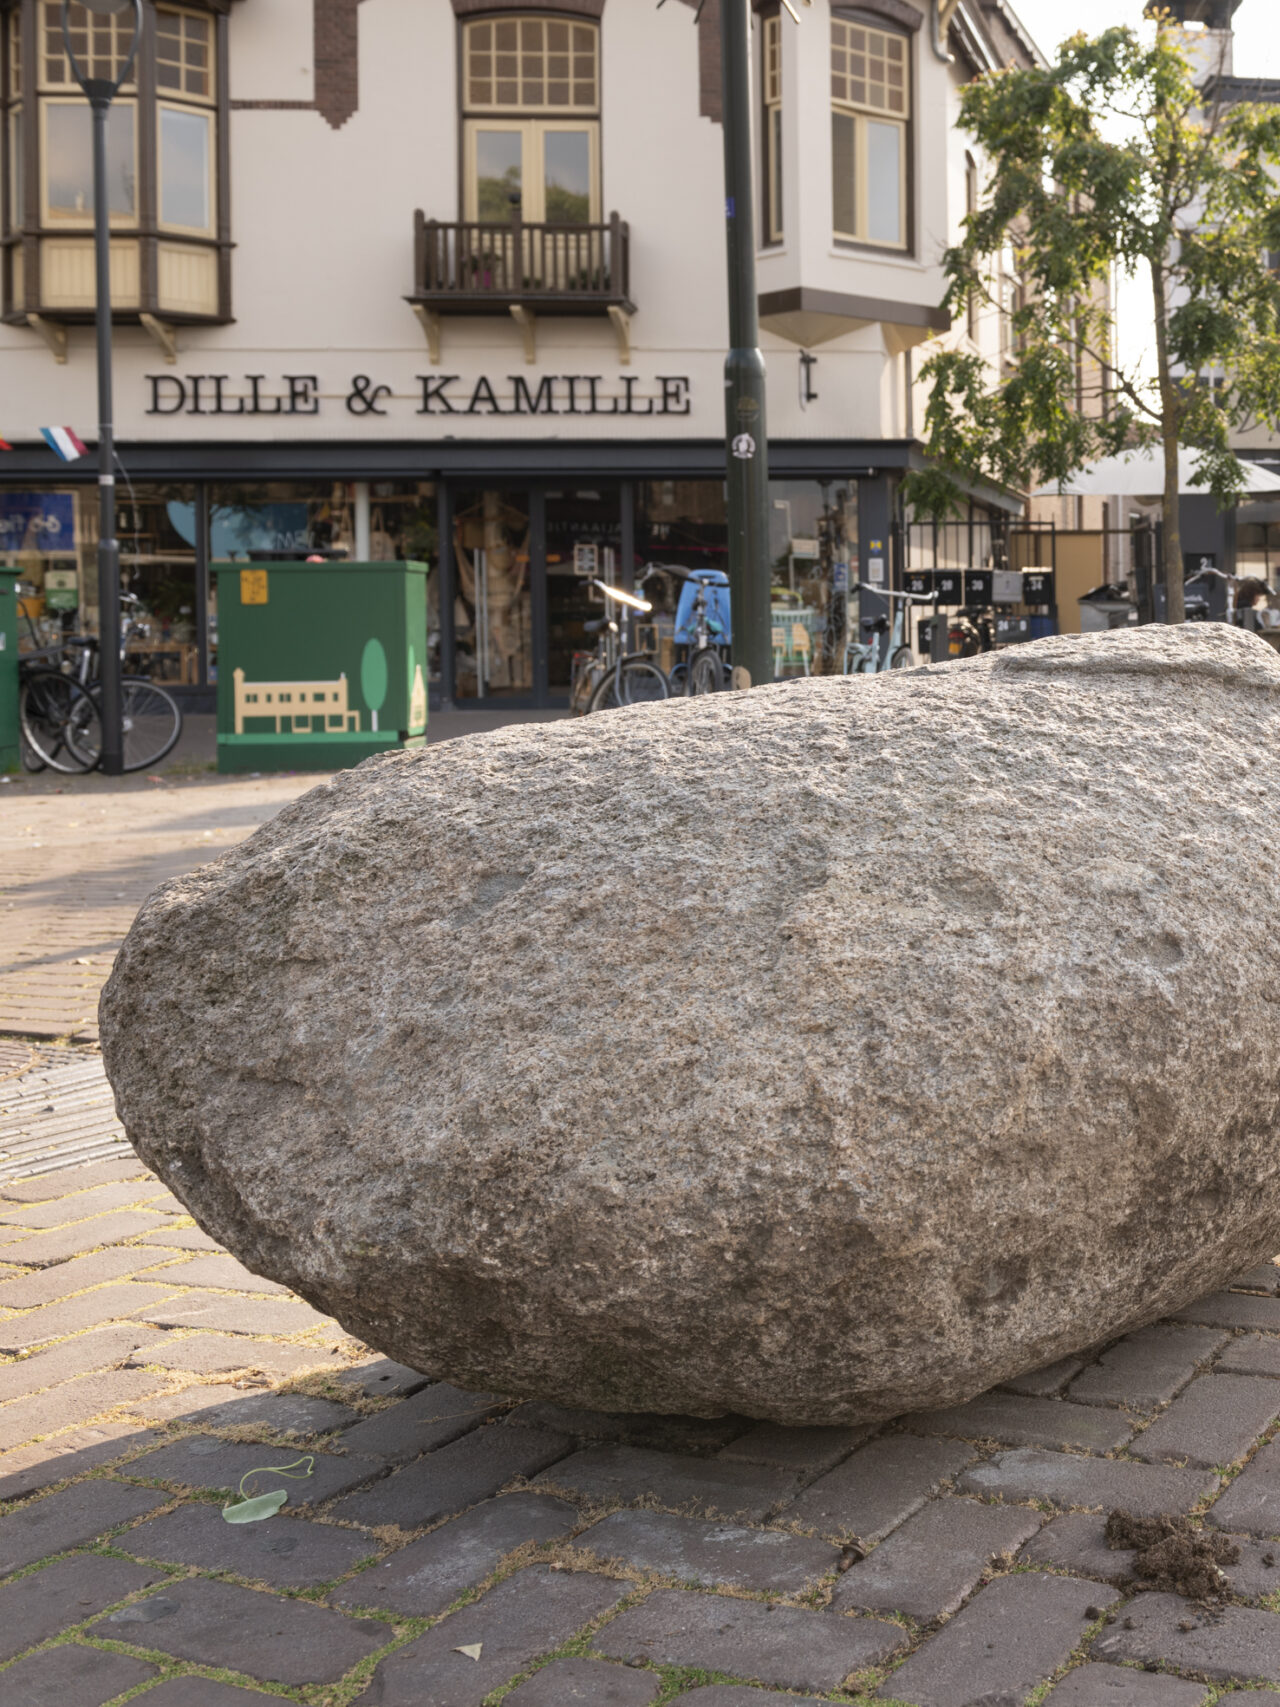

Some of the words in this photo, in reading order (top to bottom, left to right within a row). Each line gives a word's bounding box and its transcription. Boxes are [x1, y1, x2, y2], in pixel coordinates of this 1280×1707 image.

[145, 375, 319, 415] DILLE
[346, 375, 392, 416] &
[416, 375, 690, 415] KAMILLE
